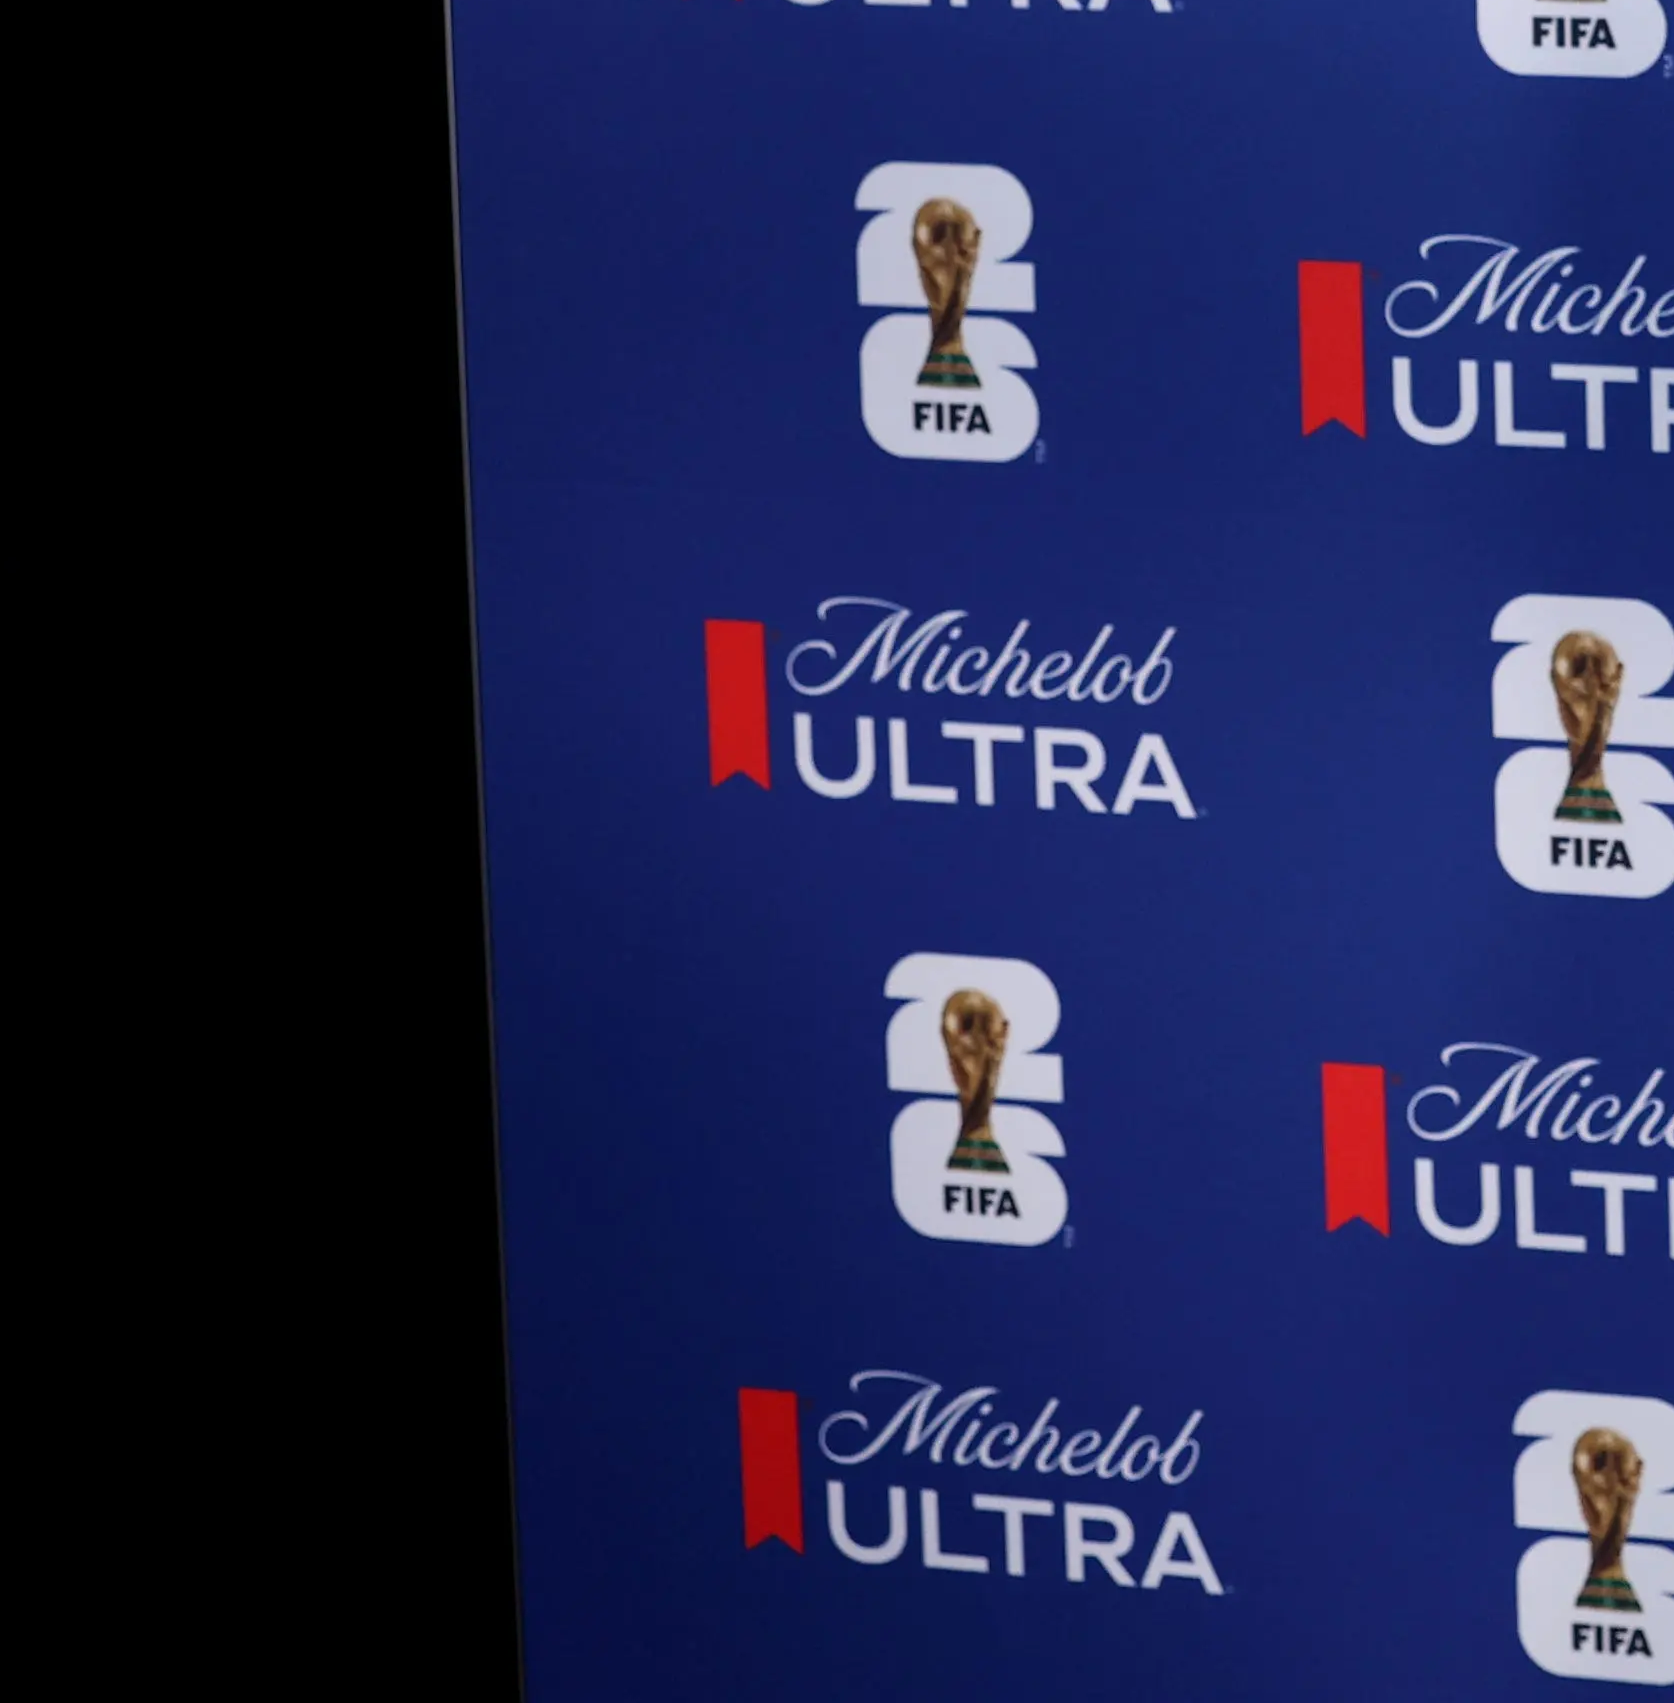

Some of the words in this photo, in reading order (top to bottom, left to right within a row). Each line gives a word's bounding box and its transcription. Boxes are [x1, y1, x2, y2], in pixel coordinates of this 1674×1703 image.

[1532, 16, 1616, 49] FIFA
[913, 401, 991, 434] FIFA
[785, 598, 1175, 705] Michelob
[794, 713, 1196, 818] ULTRA
[1551, 836, 1633, 870] FIFA
[943, 1184, 1020, 1218] FIFA
[818, 1372, 1202, 1483] Michelob
[828, 1481, 1223, 1594] ULTRA
[1572, 1623, 1652, 1657] FIFA
